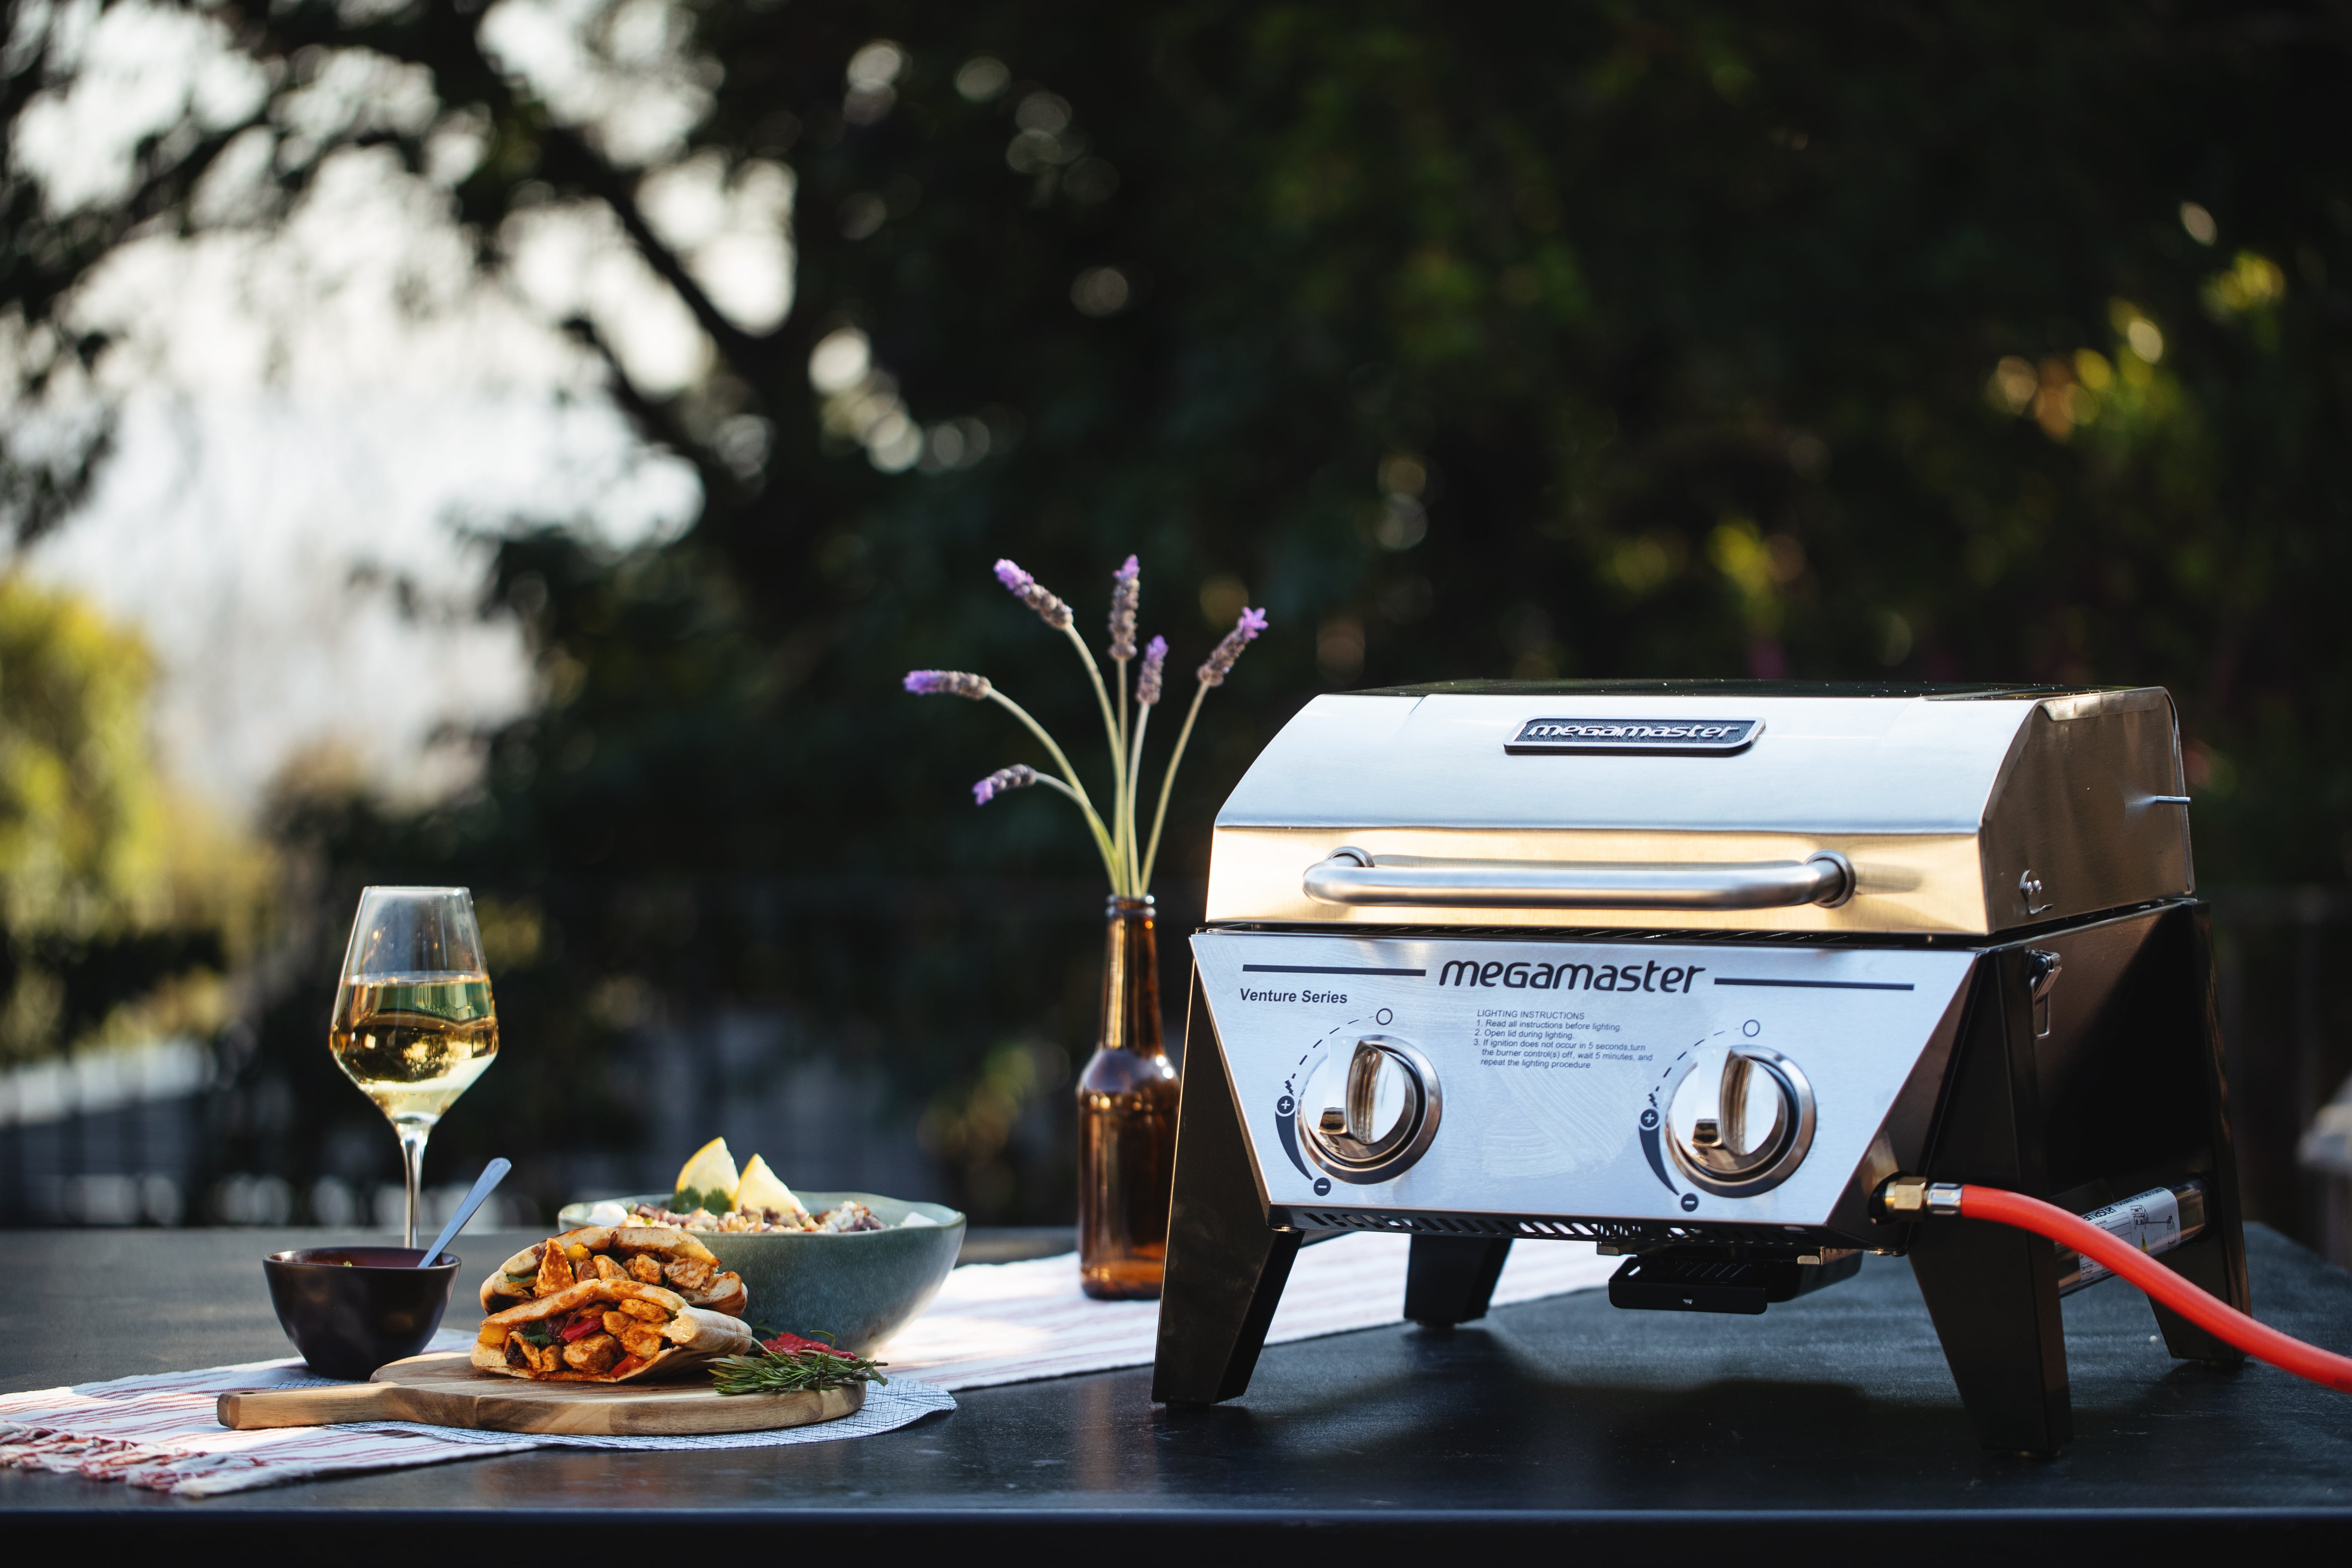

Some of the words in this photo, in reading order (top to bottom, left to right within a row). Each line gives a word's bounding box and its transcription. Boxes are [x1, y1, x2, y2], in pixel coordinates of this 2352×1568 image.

[1527, 723, 1740, 739] megamaster
[1439, 960, 1706, 994] megamaster
[1240, 988, 1297, 1002] Venture
[1302, 990, 1348, 1003] Series
[1477, 1009, 1518, 1018] LIGHTING
[1520, 1011, 1585, 1020] INSTRUCTIONS
[1592, 1023, 1622, 1032] lighting.
[1485, 1029, 1505, 1038] Open
[1519, 1030, 1543, 1039] during
[1545, 1031, 1574, 1040] lighting.
[1491, 1039, 1518, 1047] ignition
[1524, 1050, 1560, 1059] control(s)
[1603, 1053, 1635, 1061] minutes,
[1522, 1059, 1549, 1068] lighting
[2081, 1206, 2116, 1221] amaster
